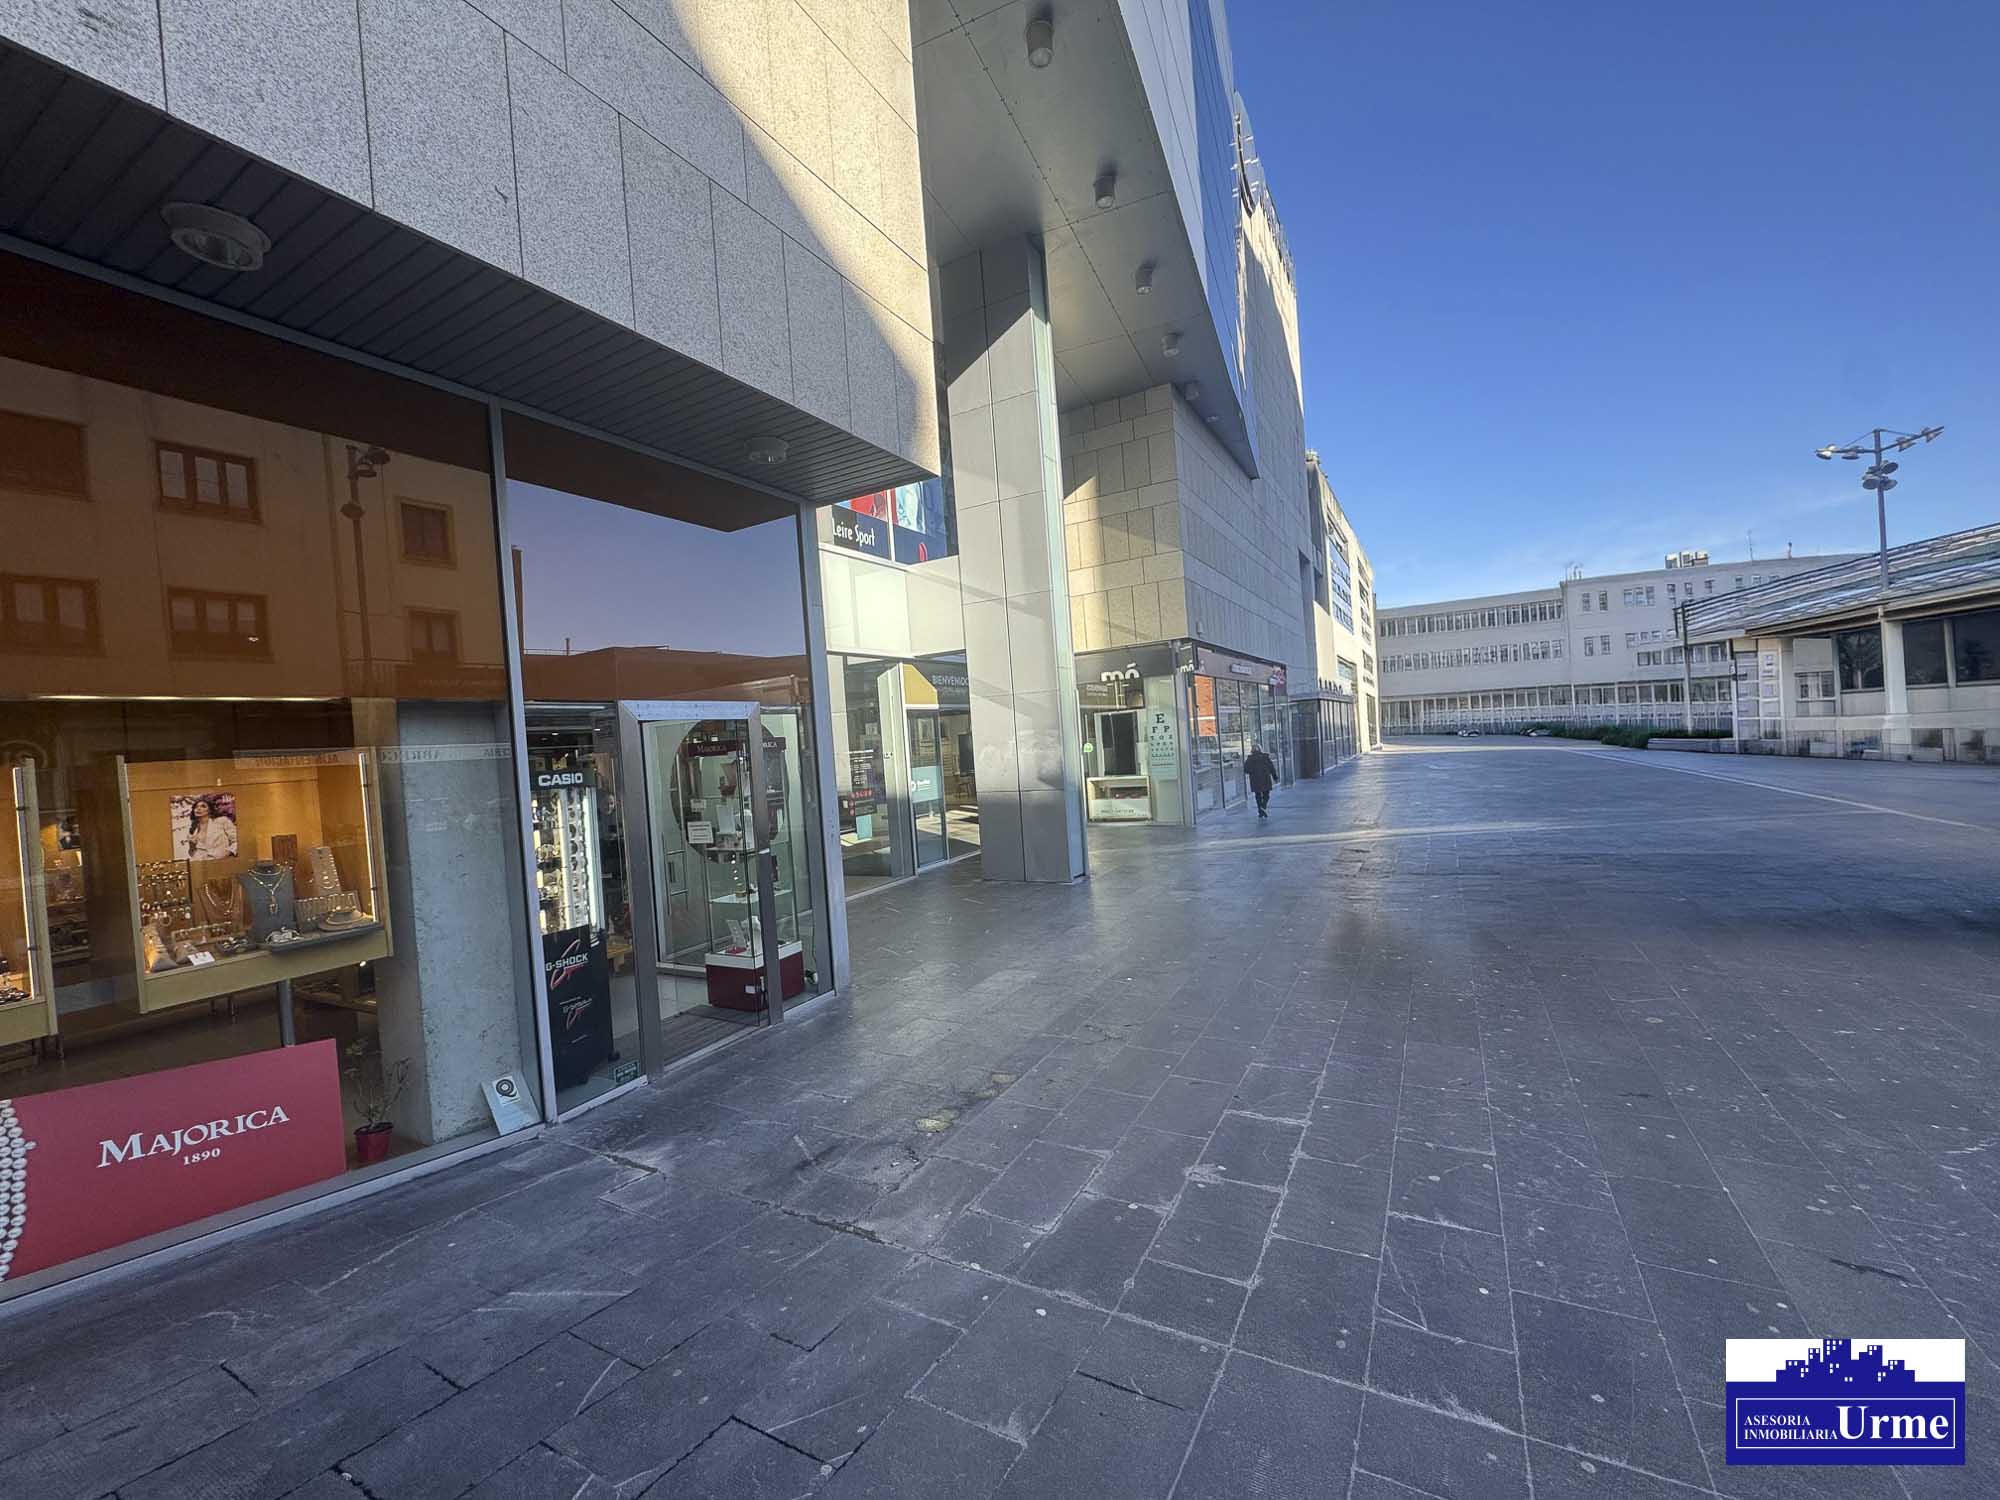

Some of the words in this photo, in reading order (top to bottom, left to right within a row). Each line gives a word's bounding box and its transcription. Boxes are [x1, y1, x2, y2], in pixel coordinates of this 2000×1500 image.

[831, 517, 853, 540] Leire
[855, 524, 875, 547] Sport
[1156, 713, 1165, 724] E
[538, 772, 583, 787] CASIO
[546, 952, 589, 972] G-SHOCK
[96, 1105, 291, 1168] MAJORICA
[183, 1147, 221, 1166] 1890
